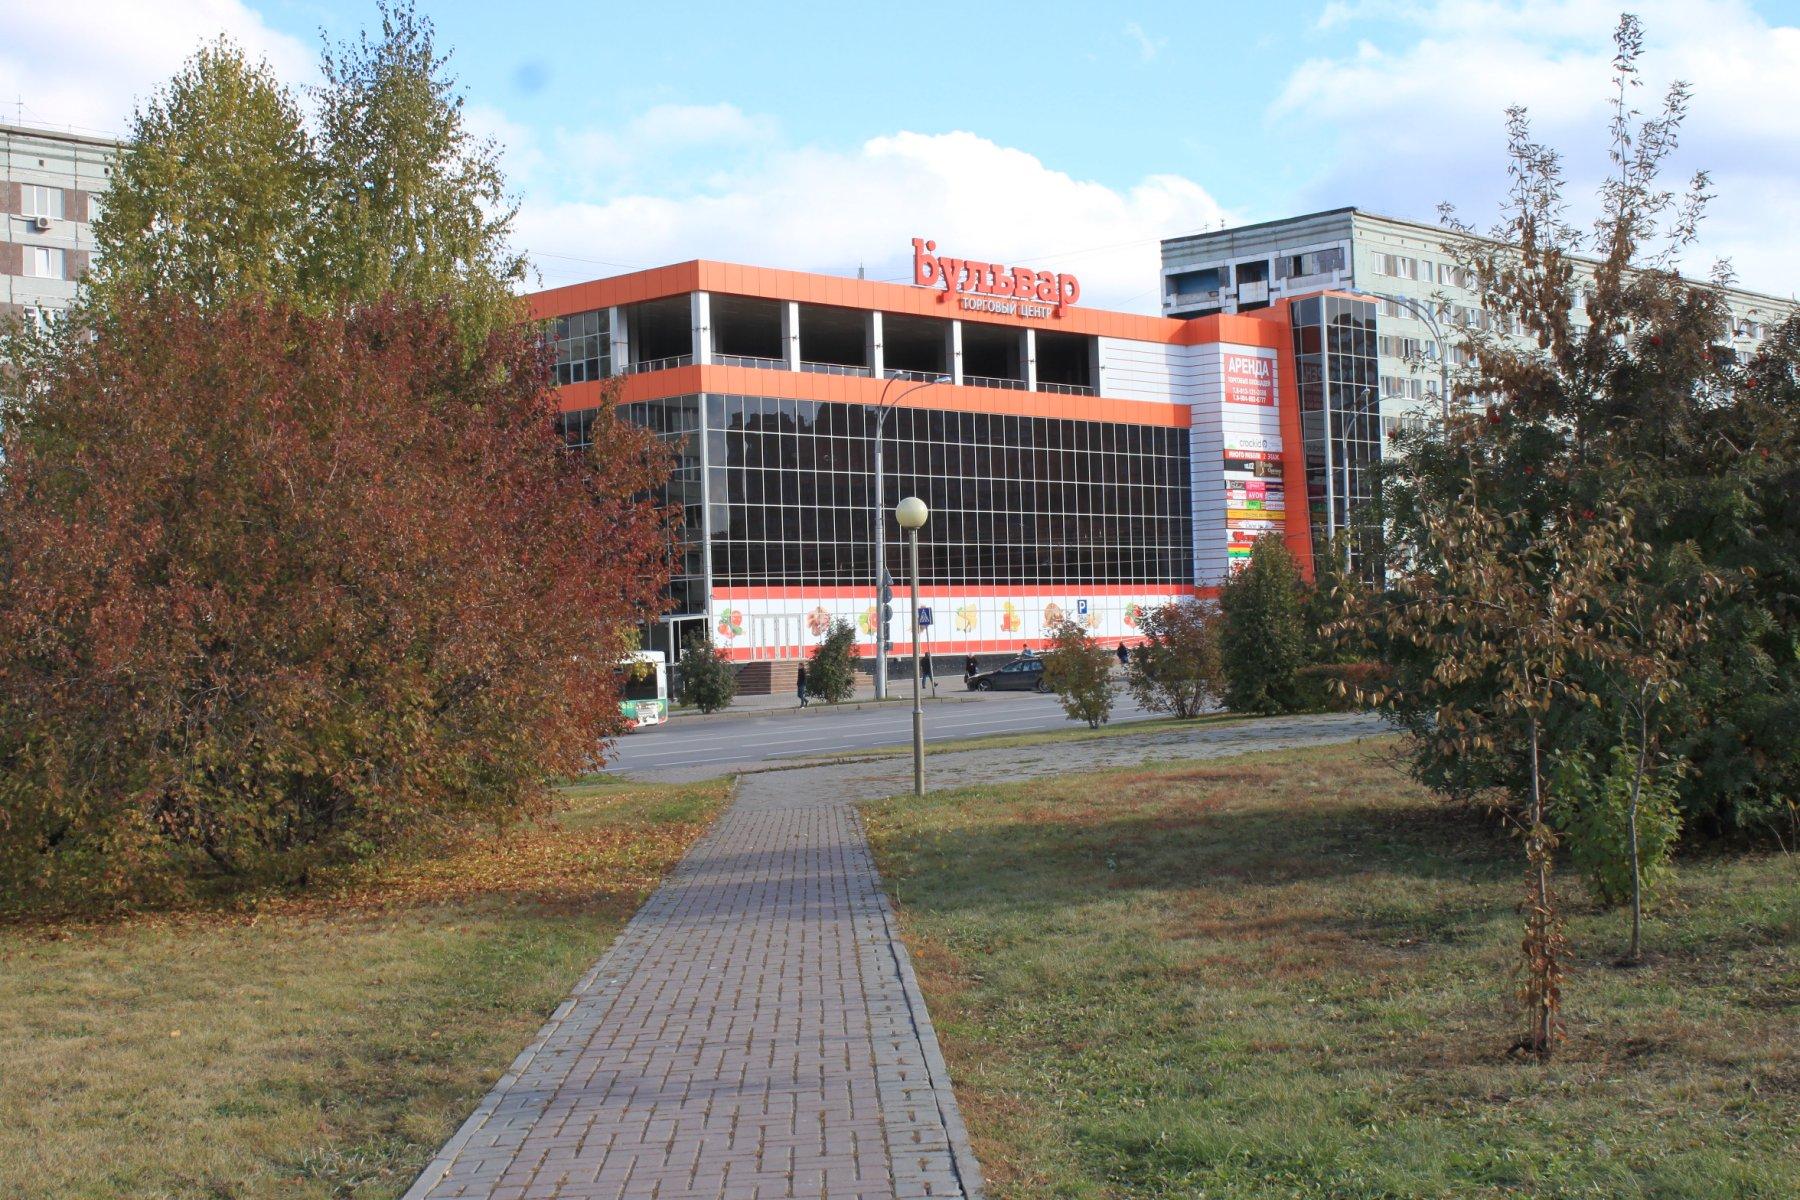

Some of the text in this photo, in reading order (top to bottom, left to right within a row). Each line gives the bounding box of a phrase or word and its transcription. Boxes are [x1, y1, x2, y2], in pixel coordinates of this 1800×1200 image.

[963, 298, 1052, 319] ТОРГОВЫЙ ЦЕНТР
[1228, 357, 1269, 378] АРЕНДА
[1240, 439, 1262, 448] crockid
